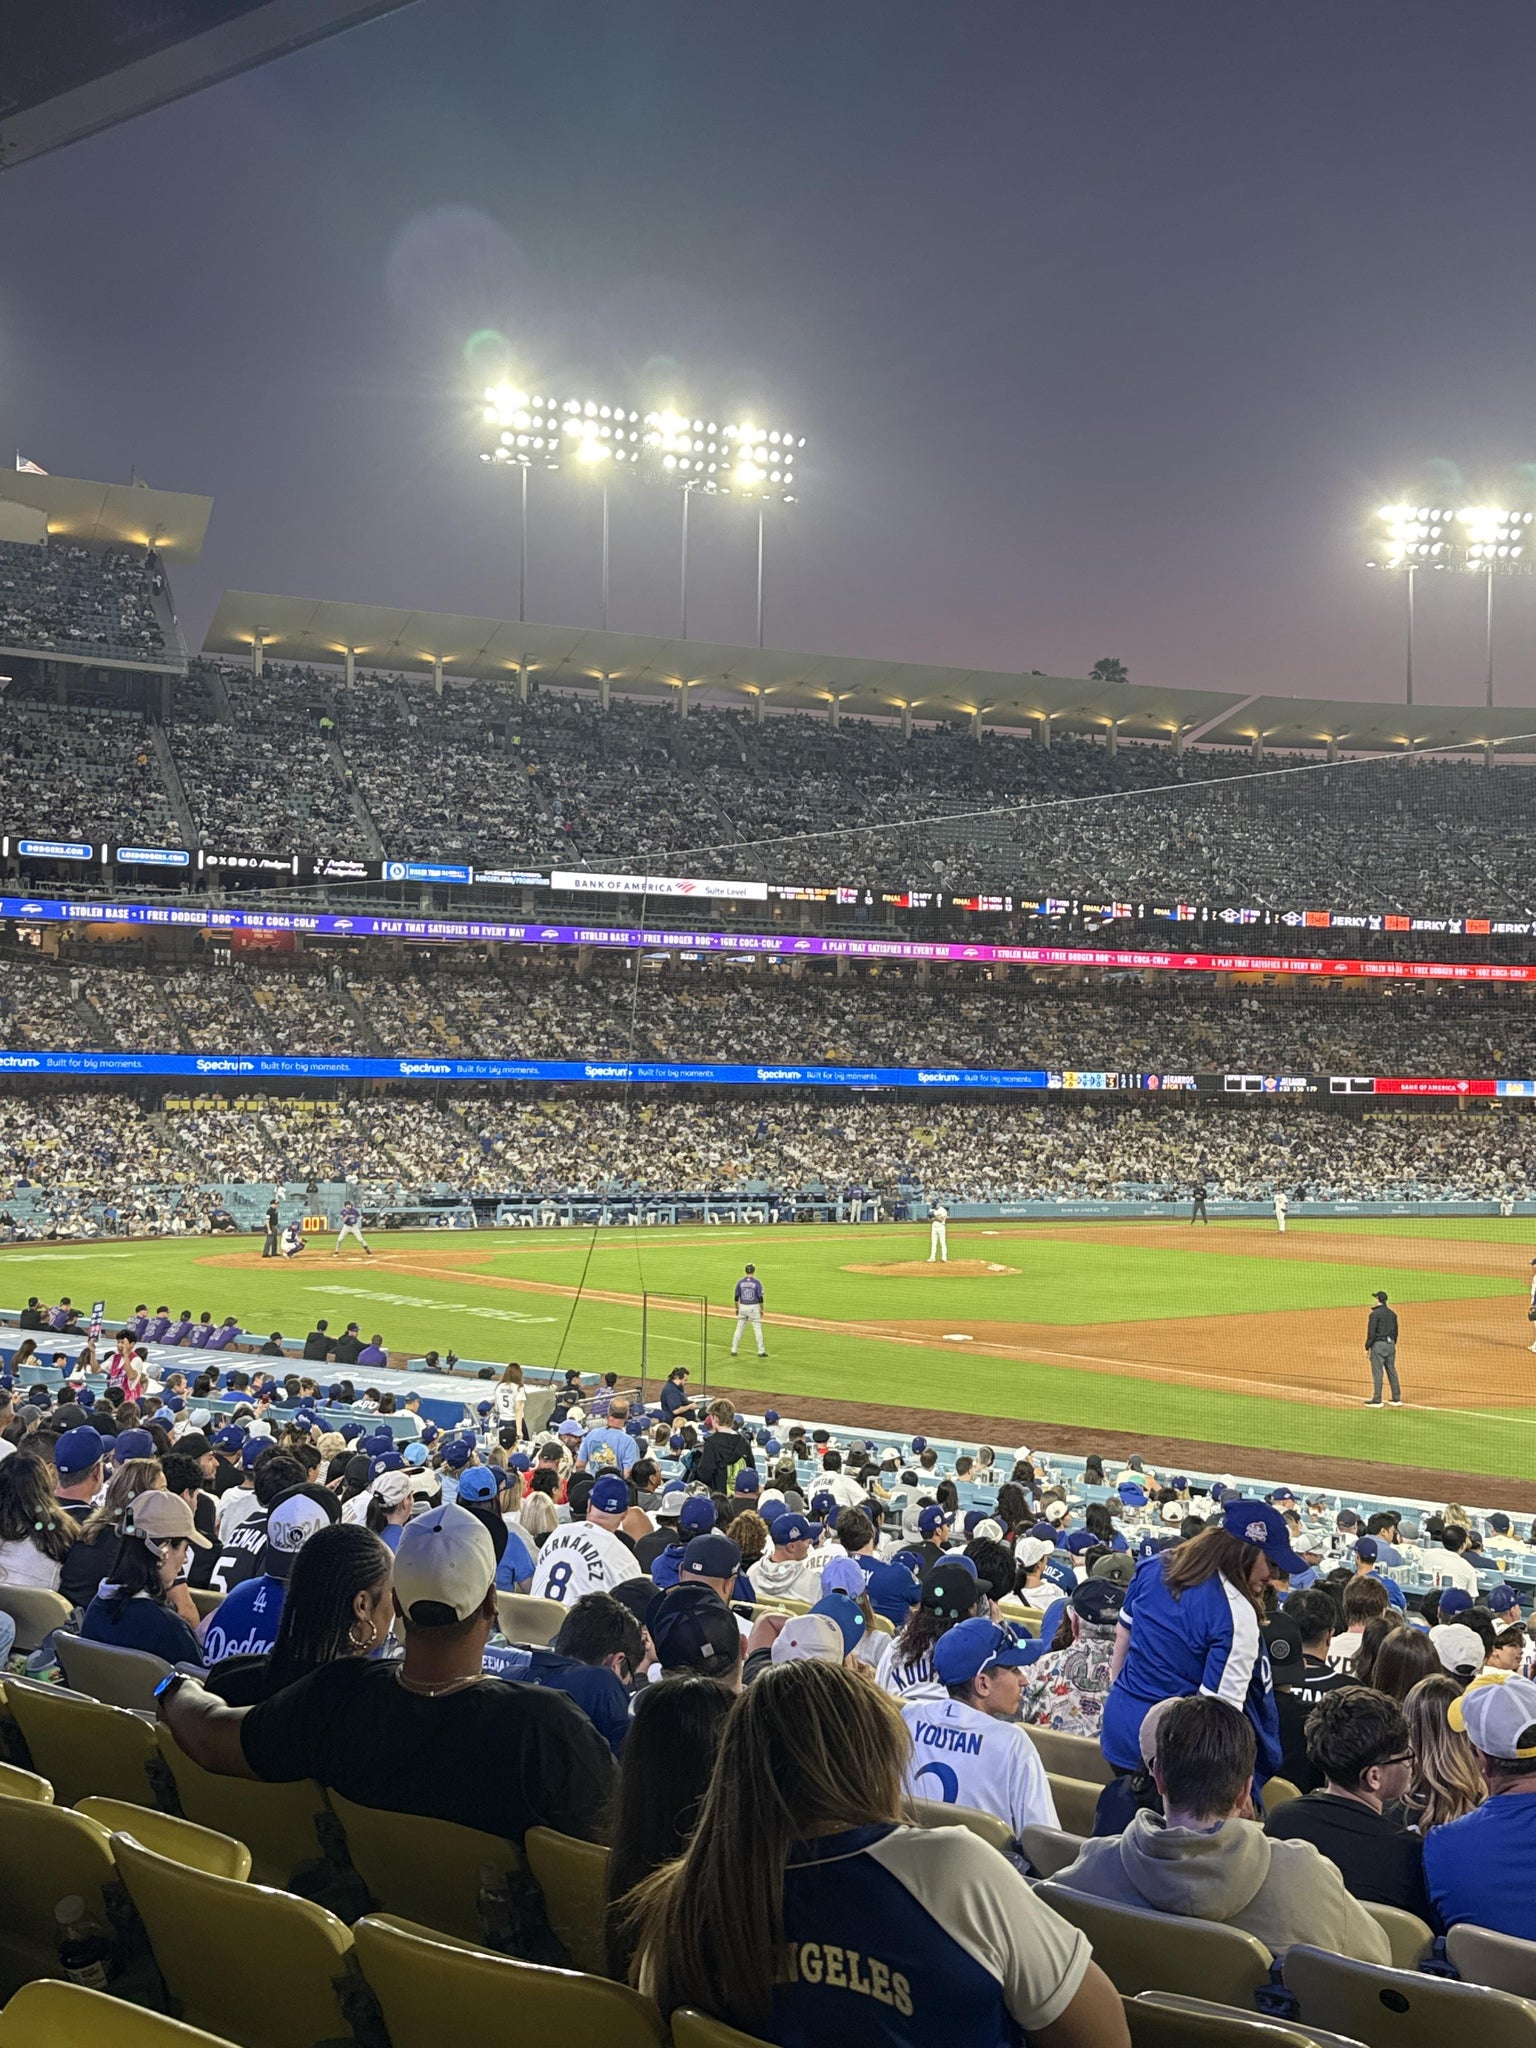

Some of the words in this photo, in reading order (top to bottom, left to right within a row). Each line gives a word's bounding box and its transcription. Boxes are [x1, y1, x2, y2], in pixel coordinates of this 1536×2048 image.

[26, 844, 84, 855] DODGERS.COM
[574, 880, 604, 889] BANK
[608, 881, 621, 889] OF
[624, 882, 673, 892] AMERICA
[70, 906, 103, 917] STOLEN
[106, 908, 129, 918] BASE
[147, 911, 169, 921] FREE
[171, 911, 207, 922] DODGER
[1331, 916, 1367, 927] JERKY
[1411, 920, 1447, 931] JERKY
[1492, 923, 1530, 933] JERKY
[381, 922, 402, 932] PLAY
[405, 923, 425, 932] THAT
[428, 924, 468, 934] SATISFIES
[470, 926, 480, 935] IN
[482, 926, 506, 936] EVERY
[509, 928, 525, 937] WAY
[580, 932, 609, 941] STOLEN
[610, 932, 629, 942] BASE
[644, 934, 661, 943] FREE
[663, 935, 693, 944] DODGER
[829, 942, 846, 951] PLAY
[849, 943, 866, 952] THAT
[867, 944, 901, 954] SATISFIES
[903, 945, 911, 954] IN
[913, 946, 933, 955] EVERY
[936, 948, 950, 956] WAY
[997, 950, 1021, 959] STOLEN
[1023, 951, 1039, 959] BASE
[1052, 952, 1066, 960] FREE
[1068, 953, 1094, 962] DODGER
[1218, 959, 1232, 967] PLAY
[1234, 959, 1249, 967] THAT
[1251, 960, 1280, 969] SATISFIES
[1282, 961, 1289, 969] IN
[1290, 962, 1308, 970] EVERY
[1310, 962, 1322, 970] WAY
[47, 1058, 67, 1067] Built
[69, 1058, 82, 1067] for
[84, 1059, 98, 1070] big
[196, 1059, 252, 1072] Spectrum
[260, 1062, 279, 1070] Built
[281, 1062, 294, 1070] for
[295, 1062, 308, 1073] big
[400, 1063, 448, 1075] Spectrum
[457, 1065, 474, 1073] Built
[476, 1065, 487, 1073] for
[489, 1065, 501, 1076] big
[585, 1066, 627, 1078] Spectrum
[638, 1068, 654, 1077] Built
[655, 1069, 666, 1077] for
[668, 1069, 679, 1079] big
[757, 1069, 799, 1081] Spectrum
[823, 1072, 832, 1080] for
[834, 1072, 845, 1082] big
[303, 1216, 327, 1231] 007
[502, 1395, 509, 1408] 5
[539, 1534, 604, 1581] HERNÁNDEZ
[806, 1554, 834, 1568] FREE
[210, 1556, 237, 1594] 5
[544, 1560, 573, 1602] 8
[253, 1586, 267, 1613] LA
[915, 1720, 984, 1755] YOUTAN
